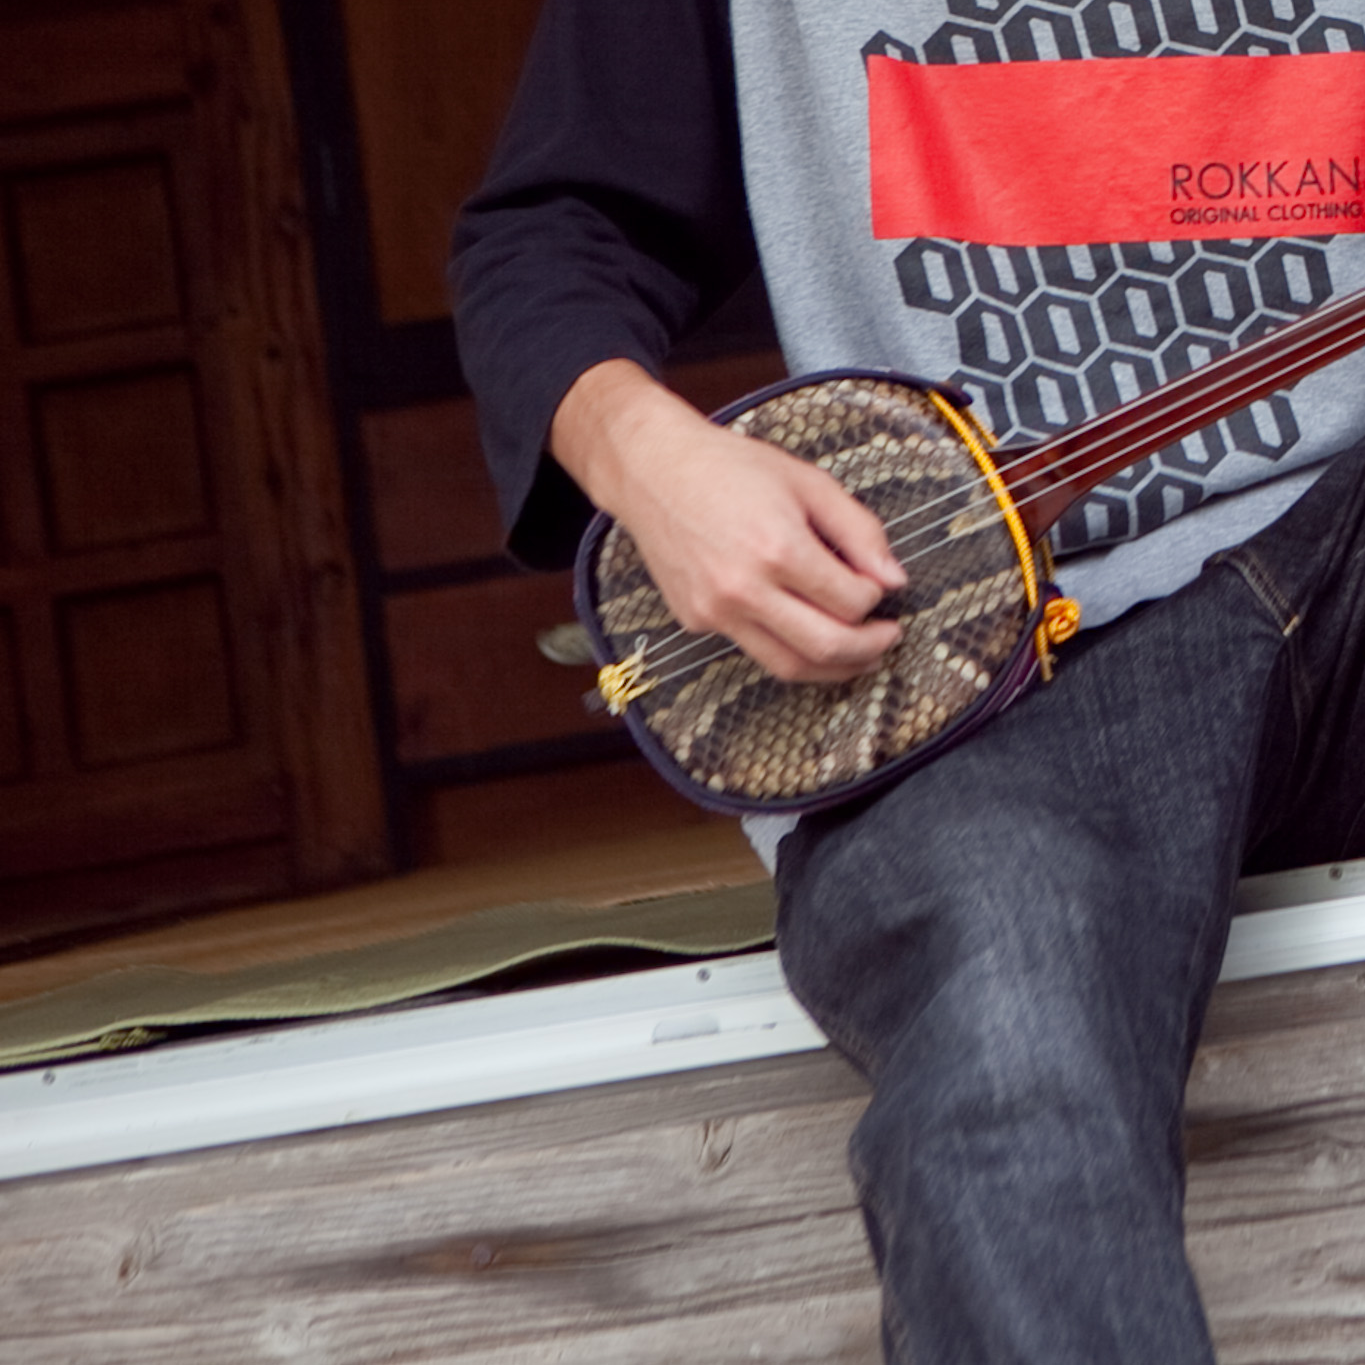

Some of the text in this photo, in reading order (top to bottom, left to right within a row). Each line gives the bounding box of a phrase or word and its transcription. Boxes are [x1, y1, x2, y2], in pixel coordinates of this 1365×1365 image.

[1170, 156, 1360, 201] ROKKAN
[1169, 200, 1365, 226] ORIGINAL CLOTHING
